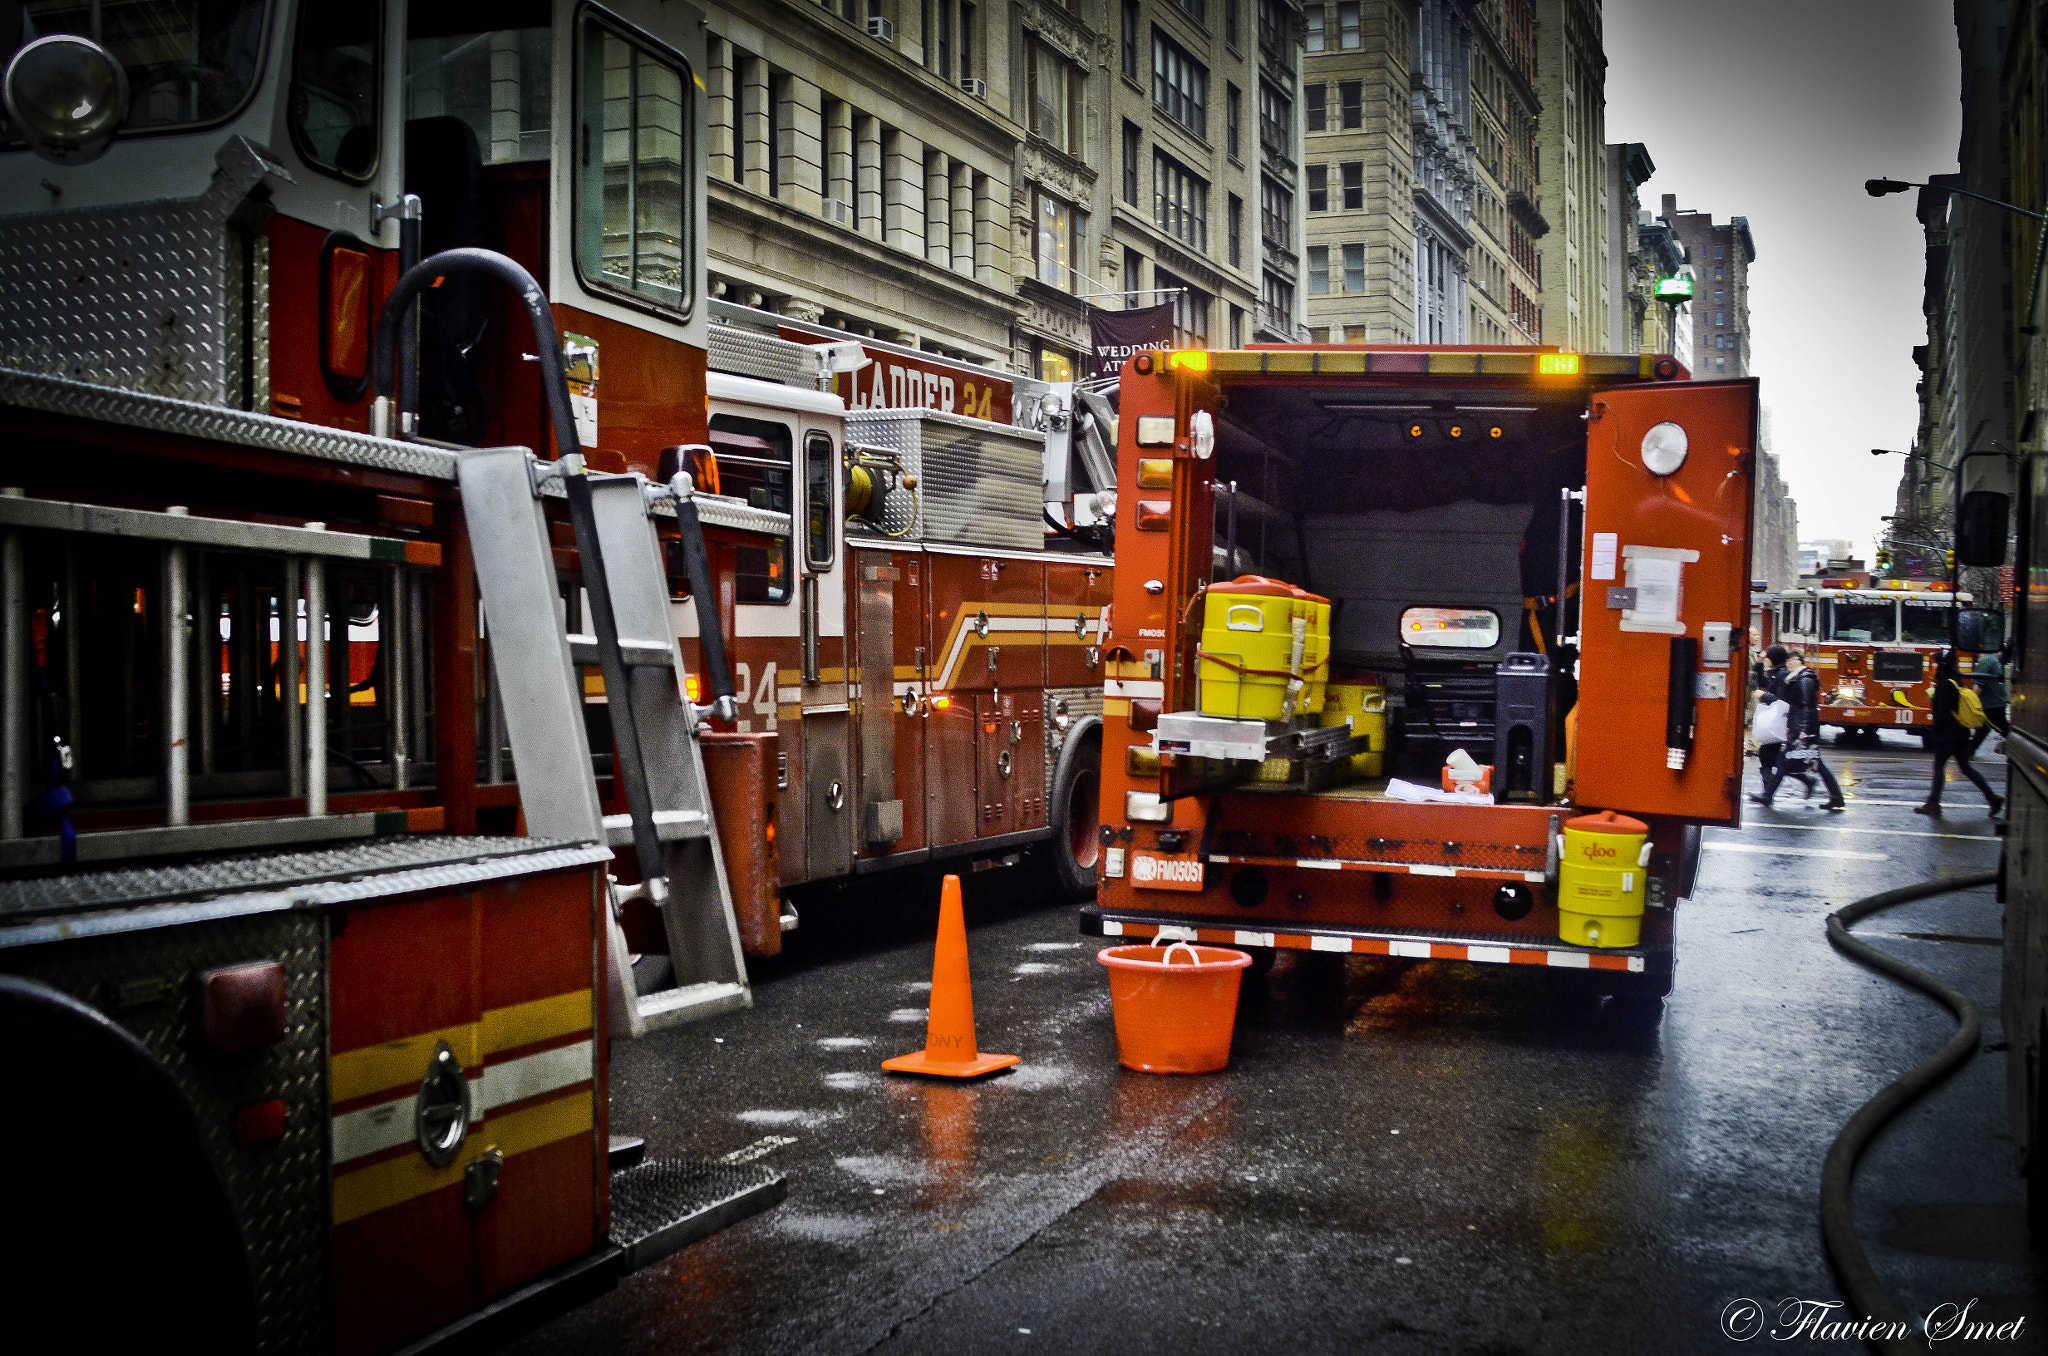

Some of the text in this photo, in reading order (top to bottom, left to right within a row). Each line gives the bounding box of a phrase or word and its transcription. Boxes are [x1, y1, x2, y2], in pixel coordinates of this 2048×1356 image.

[1097, 339, 1170, 358] WEDDING
[850, 361, 992, 421] LADDER 24
[1926, 600, 1963, 608] TROOS
[735, 661, 777, 734] 24
[1894, 709, 1913, 724] 10
[1157, 860, 1202, 882] FM05051
